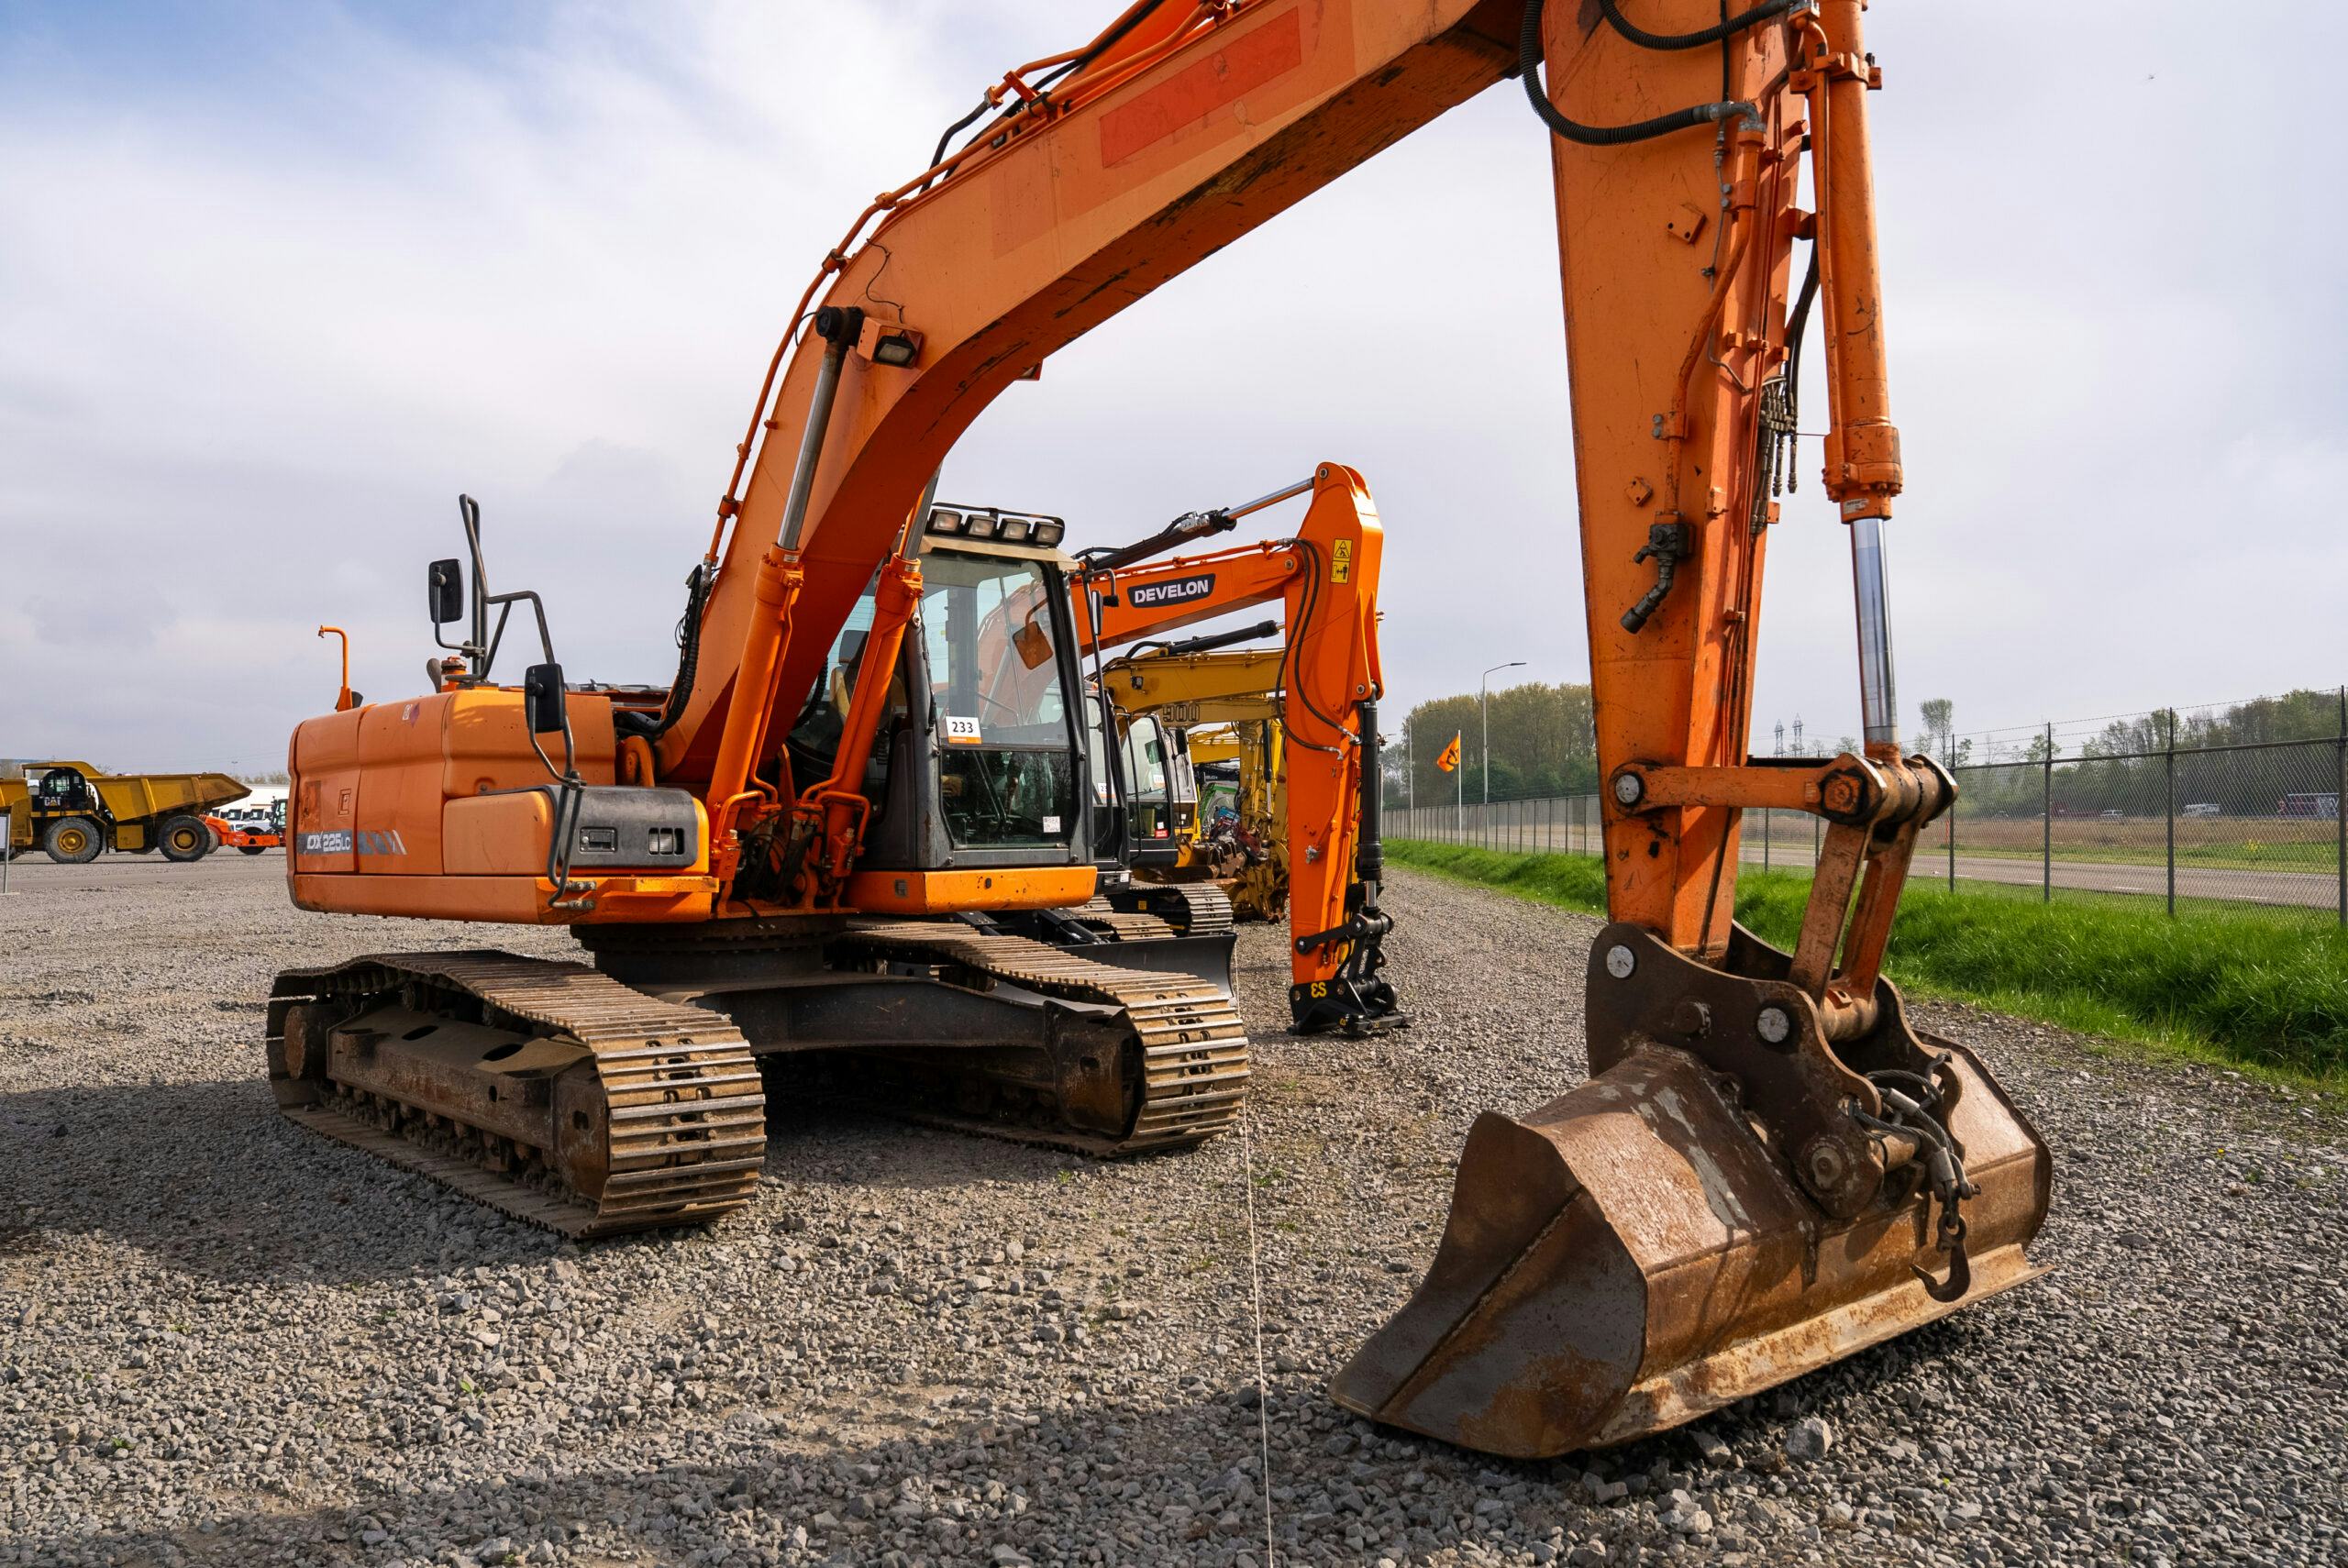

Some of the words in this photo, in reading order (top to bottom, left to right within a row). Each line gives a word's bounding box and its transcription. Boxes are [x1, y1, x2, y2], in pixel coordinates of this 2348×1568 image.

[1135, 580, 1209, 603] DEVELON
[951, 722, 974, 734] 233
[44, 797, 61, 807] CAT
